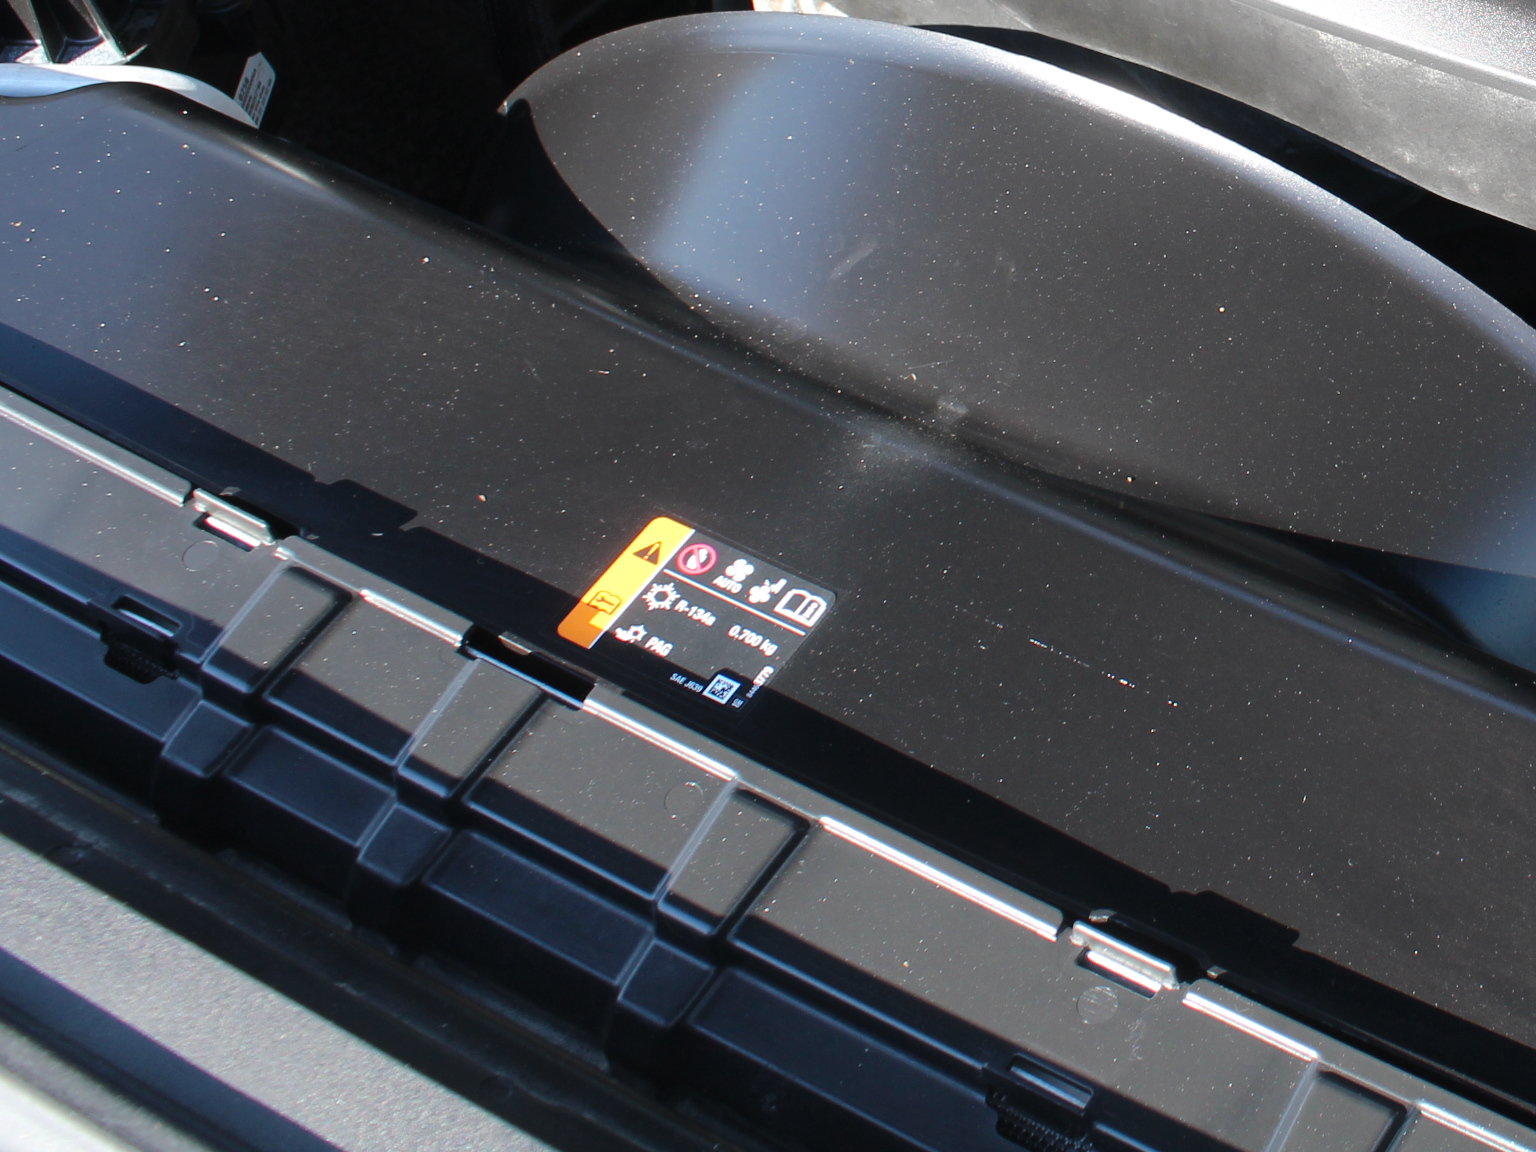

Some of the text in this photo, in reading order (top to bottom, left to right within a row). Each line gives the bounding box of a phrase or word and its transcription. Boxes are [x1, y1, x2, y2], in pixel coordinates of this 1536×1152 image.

[712, 575, 743, 594] AUTO
[674, 600, 718, 627] R-134a
[644, 636, 674, 657] PAG
[728, 625, 778, 656] 0.700 kg
[670, 673, 686, 688] SAE
